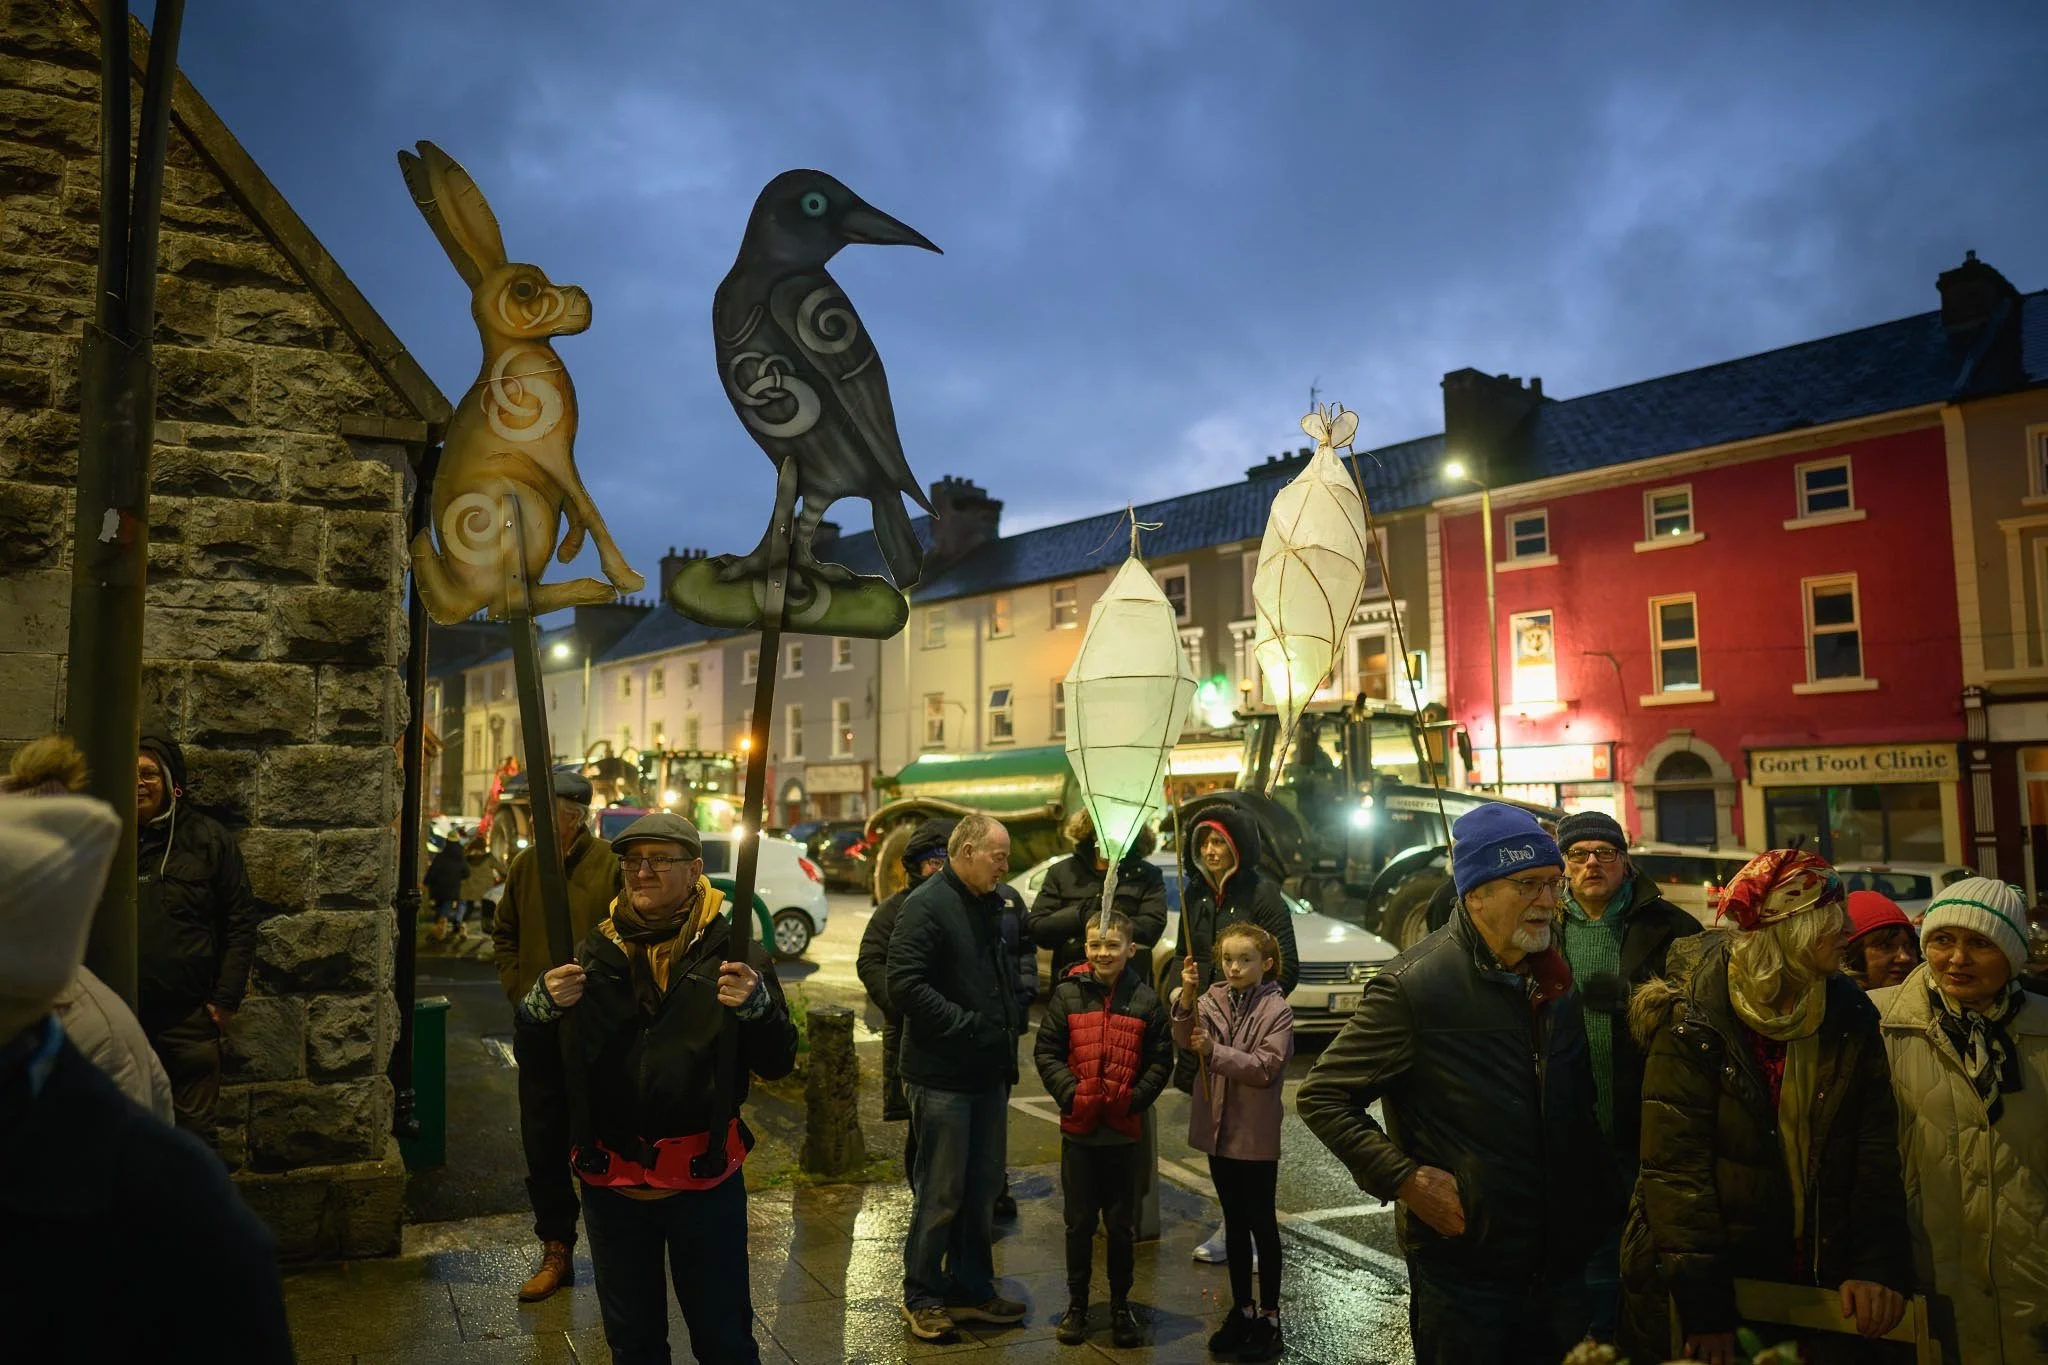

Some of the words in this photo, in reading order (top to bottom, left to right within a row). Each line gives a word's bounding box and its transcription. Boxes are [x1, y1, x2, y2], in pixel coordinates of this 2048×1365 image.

[1759, 755, 1811, 774] Gort
[1816, 752, 1869, 772] Foot
[1874, 749, 1949, 771] Clinic
